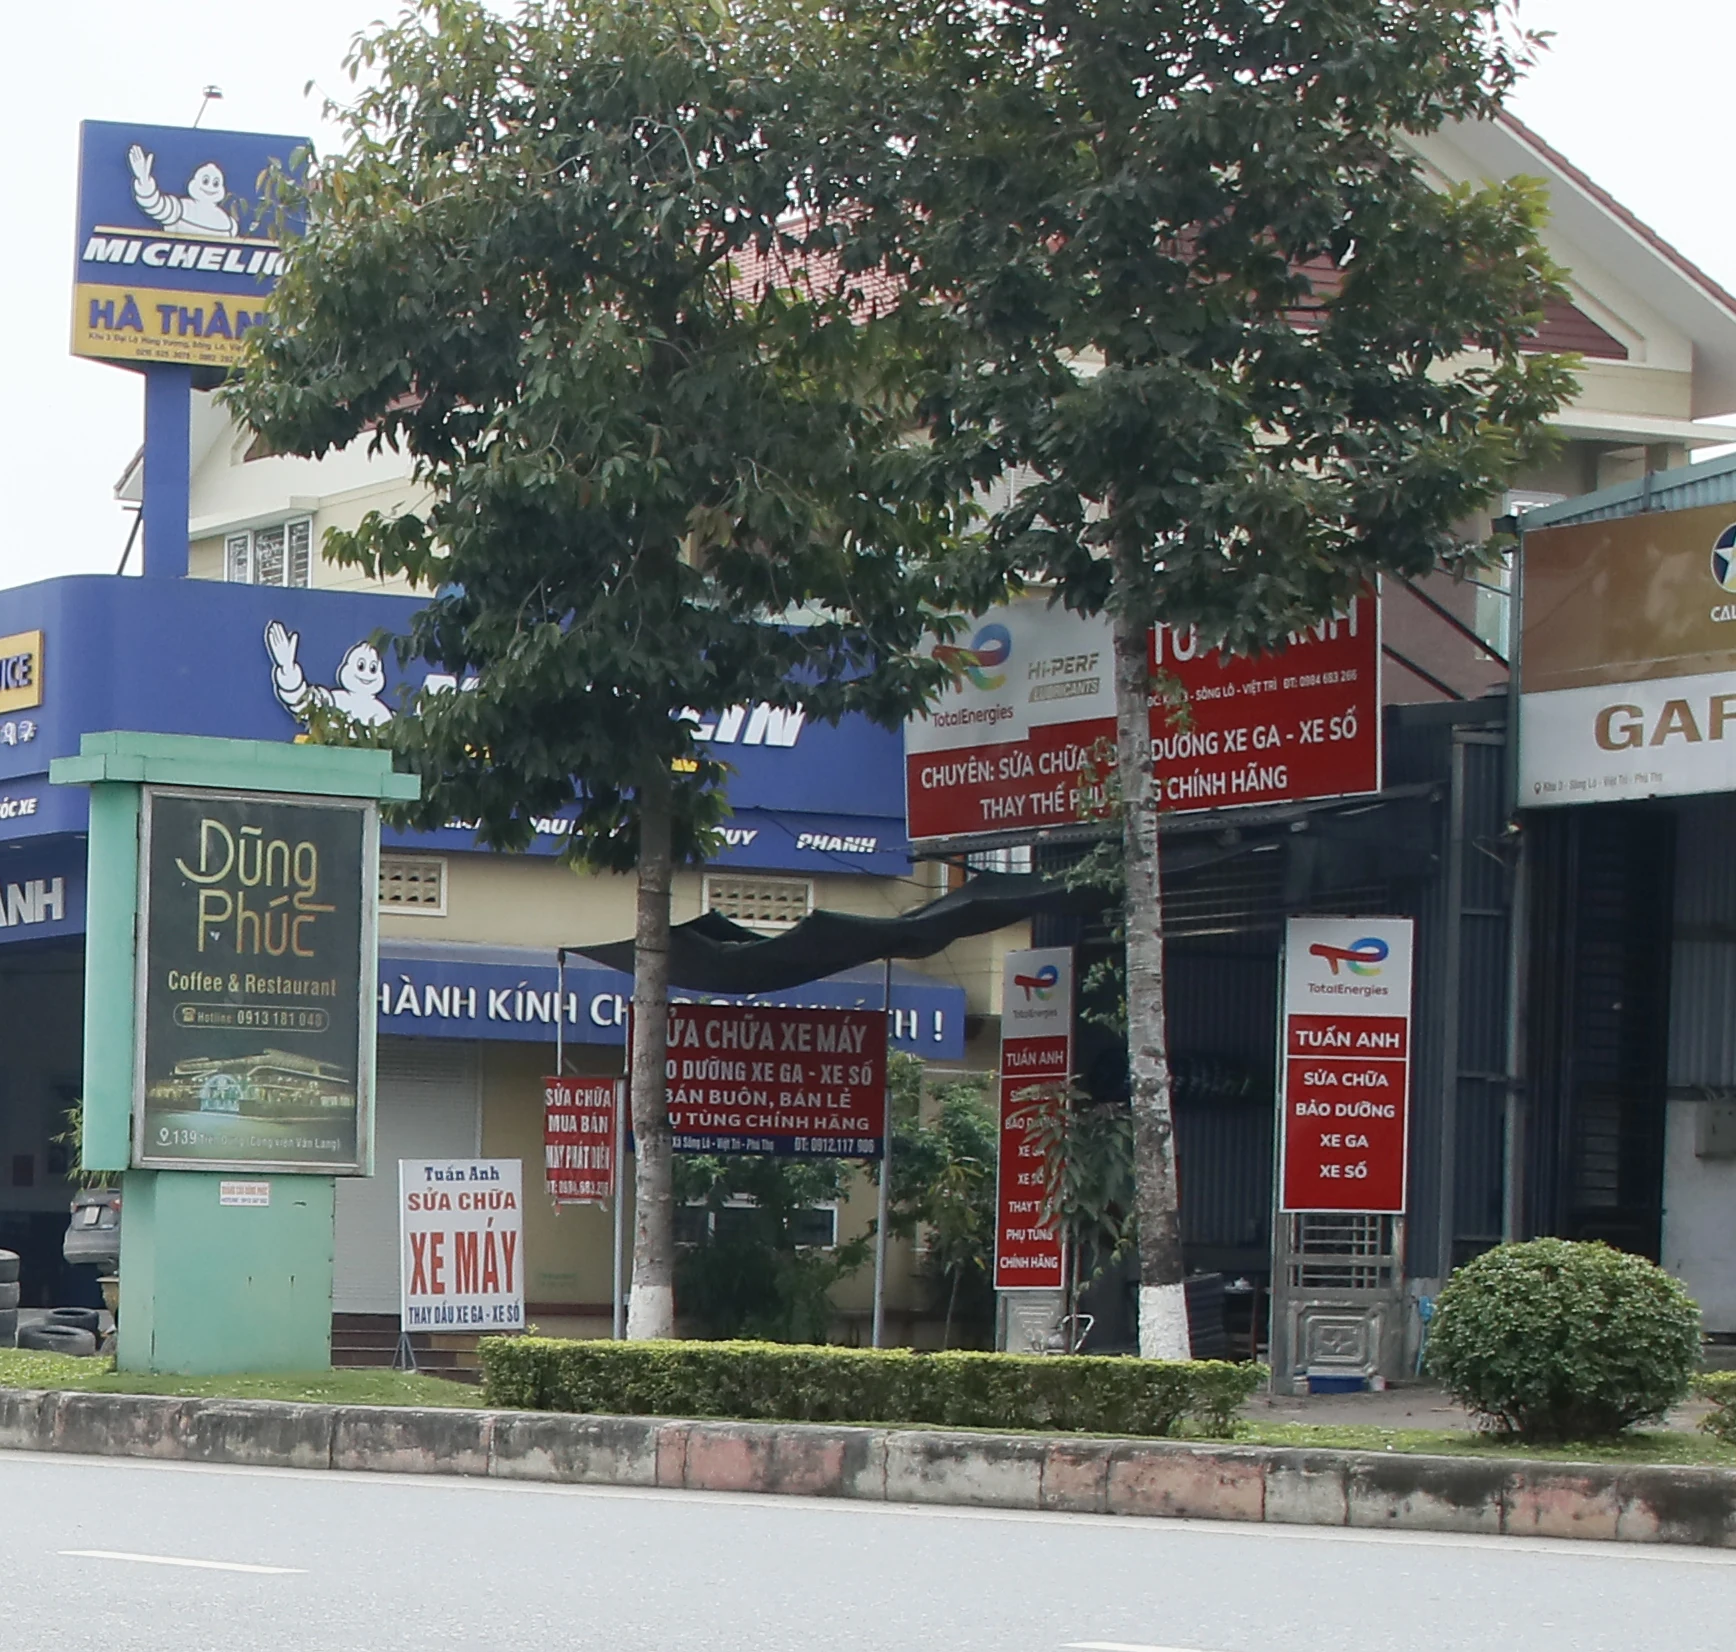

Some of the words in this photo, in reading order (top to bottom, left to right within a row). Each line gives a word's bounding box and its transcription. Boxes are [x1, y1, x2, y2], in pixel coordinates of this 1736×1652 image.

[88, 293, 144, 333] HÀ
[1028, 652, 1100, 681] Hi-PERF
[1242, 679, 1261, 696] VIỆT
[1263, 676, 1277, 691] TRÌ
[1283, 676, 1298, 689] ĐT:
[932, 704, 1014, 728] TotalEnergies
[921, 756, 995, 789] CHUYÊN:
[998, 750, 1034, 780] SỬA
[1038, 744, 1089, 776] CHỮA
[1223, 727, 1248, 754] XE
[1252, 724, 1281, 750] GA
[1299, 718, 1325, 745] XE
[1329, 704, 1358, 741] SỐ
[979, 793, 1026, 821] THAY
[1029, 781, 1065, 816] THẾ
[1166, 768, 1226, 801] CHÍNH
[1231, 762, 1288, 795] HÃNG
[18, 797, 38, 815] XE
[796, 832, 877, 854] PHANH
[175, 818, 336, 911] Dũng
[196, 887, 318, 958] Phúc
[168, 970, 223, 993] Coffee
[228, 973, 240, 993] &
[245, 973, 337, 997] Restaurant
[1307, 982, 1389, 997] TotalEnergies
[487, 980, 577, 1025] KÍNH
[237, 1008, 269, 1026] 0913
[273, 1010, 295, 1027] 181
[705, 1013, 775, 1052] CHỮA
[780, 1022, 814, 1052] XE
[817, 1015, 868, 1054] MÁY
[1295, 1025, 1351, 1048] TUẤN
[1356, 1032, 1400, 1049] ANH
[1005, 1046, 1036, 1067] TUẤN
[1039, 1050, 1064, 1065] ANH
[682, 1055, 747, 1083] DƯỠNG
[751, 1062, 774, 1083] XE
[780, 1063, 803, 1084] GA
[820, 1064, 844, 1085] XE
[848, 1059, 873, 1087] SỐ
[1303, 1068, 1339, 1086] SỬA
[1341, 1069, 1389, 1087] CHỮA
[545, 1082, 572, 1107] SỬA
[575, 1086, 612, 1108] CHỮA
[665, 1087, 704, 1105] BÁN
[709, 1085, 776, 1109] BUÔN,
[780, 1089, 822, 1108] BÁN
[827, 1087, 852, 1109] LẺ
[1295, 1098, 1331, 1117] BẢO
[1335, 1100, 1396, 1118] DƯỠNG
[548, 1114, 578, 1133] MUA
[581, 1112, 609, 1134] BÁN
[686, 1109, 742, 1128] TÙNG
[745, 1112, 809, 1130] CHÍNH
[814, 1113, 870, 1131] HÃNG
[172, 1129, 197, 1146] 139
[1319, 1133, 1341, 1148] XE
[1345, 1134, 1369, 1148] GA
[545, 1140, 566, 1169] MÁY
[1017, 1144, 1031, 1157] XE
[424, 1164, 465, 1182] Tuấn
[469, 1165, 500, 1182] Anh
[1017, 1172, 1030, 1185] XE
[1319, 1164, 1341, 1178] XE
[1344, 1160, 1368, 1179] SỐ
[407, 1186, 452, 1211] SỬA
[458, 1188, 517, 1211] CHỮA
[1008, 1200, 1033, 1213] THAY
[1005, 1228, 1026, 1244] PHỤ
[409, 1231, 446, 1296] XE
[454, 1216, 517, 1295] MÁY
[999, 1252, 1029, 1269] CHÍNH
[1030, 1253, 1059, 1269] HÃNG
[408, 1305, 433, 1325] THAY
[456, 1305, 469, 1324] XE
[471, 1305, 484, 1324] GA
[492, 1305, 505, 1323] XE
[506, 1298, 520, 1323] SỐ
